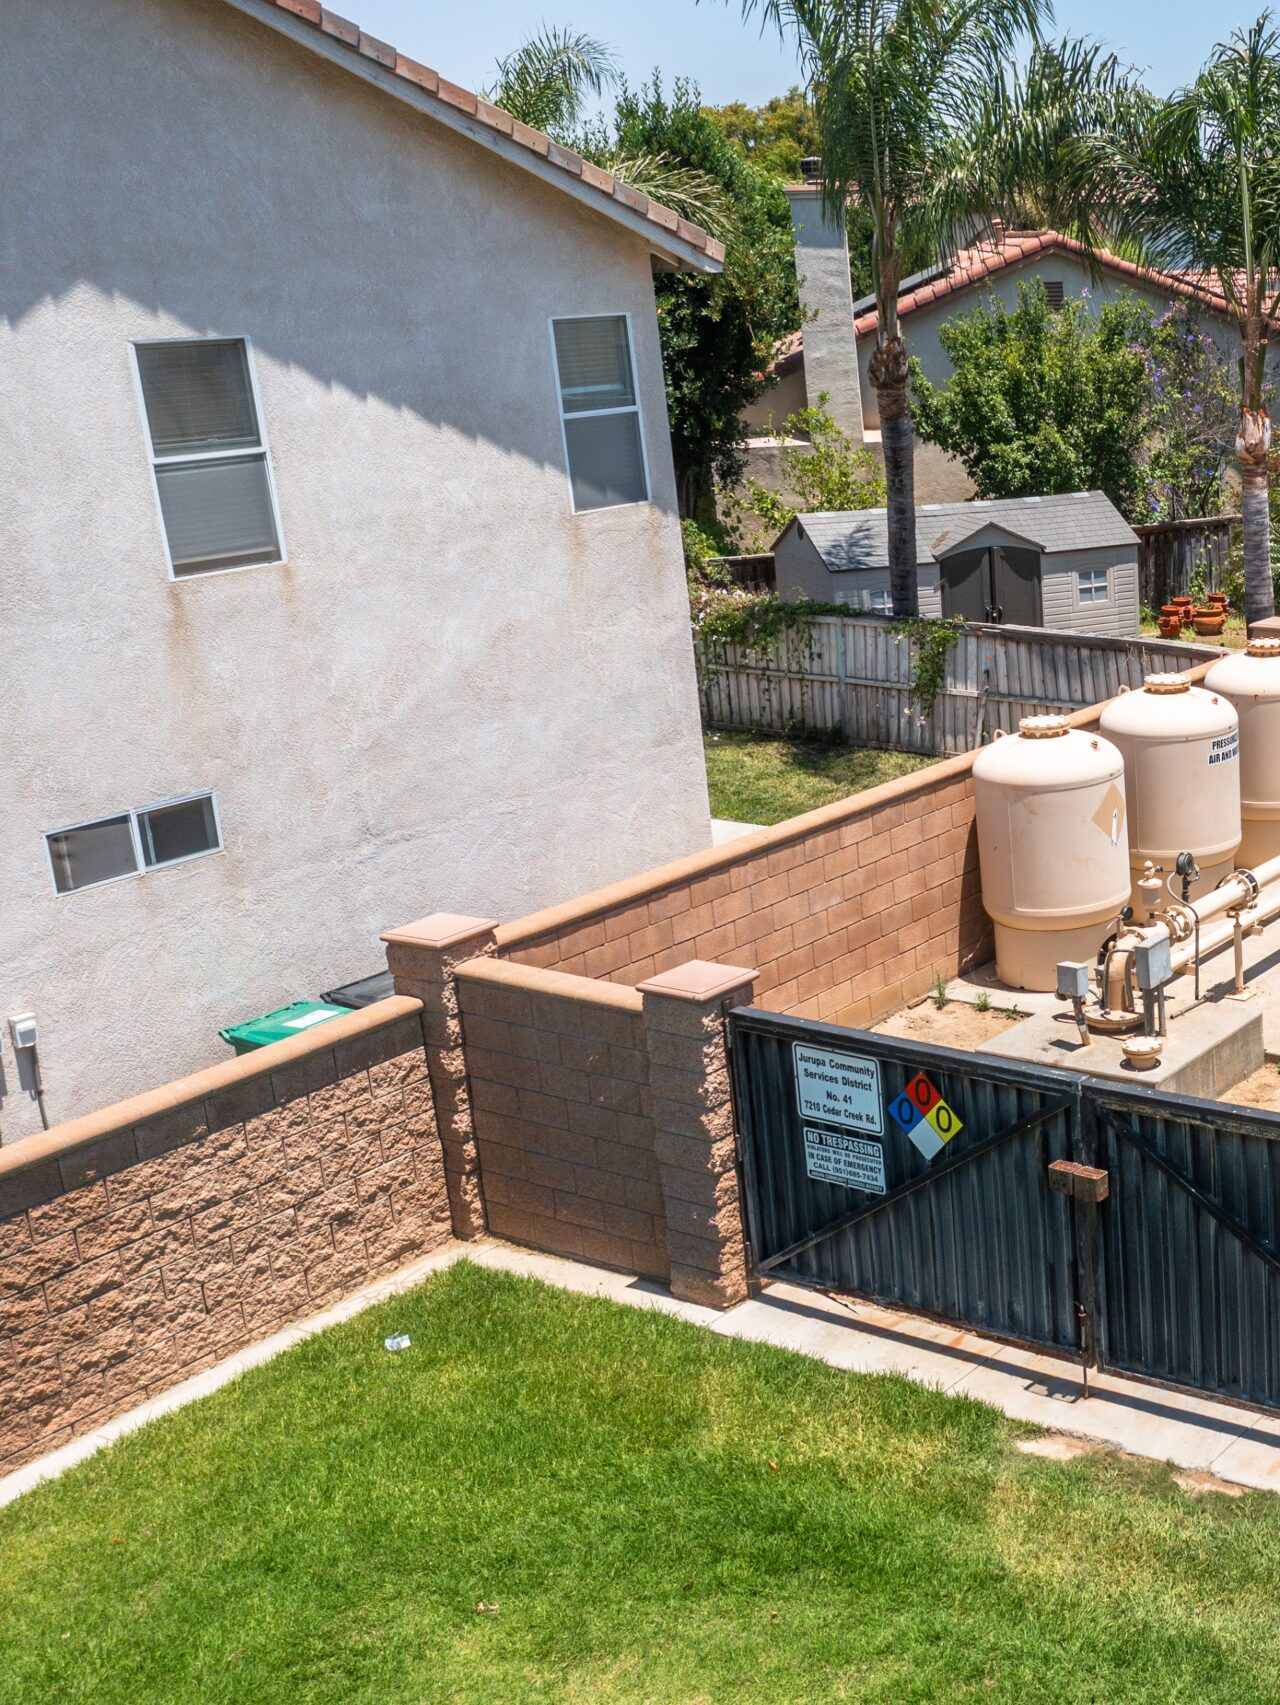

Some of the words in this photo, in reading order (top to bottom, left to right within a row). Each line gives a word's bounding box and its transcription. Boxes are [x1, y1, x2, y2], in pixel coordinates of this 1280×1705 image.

[1209, 754, 1220, 764] AIR
[1222, 750, 1231, 761] AND
[798, 1053, 826, 1068] Jurupa
[829, 1059, 875, 1079] Community
[804, 1068, 838, 1083] Services
[842, 1076, 872, 1091] District
[826, 1091, 840, 1102] No.
[843, 1094, 852, 1104] 41
[915, 1078, 931, 1106] 0
[804, 1100, 820, 1112] 7210
[823, 1104, 842, 1116] Cedar
[844, 1109, 863, 1122] Creek
[866, 1114, 877, 1125] Rd.
[898, 1097, 913, 1125] 0
[936, 1106, 952, 1133] 0
[807, 1131, 819, 1143] NO
[821, 1135, 879, 1157] TRESPASSING
[807, 1144, 830, 1153] VIOLATORS
[852, 1154, 881, 1165] PROSECUTED
[814, 1162, 830, 1171] CALL
[832, 1166, 878, 1182] (951)685-7434
[816, 1154, 831, 1163] CASE
[834, 1157, 841, 1165] OF
[844, 1160, 882, 1174] EMERGENCY
